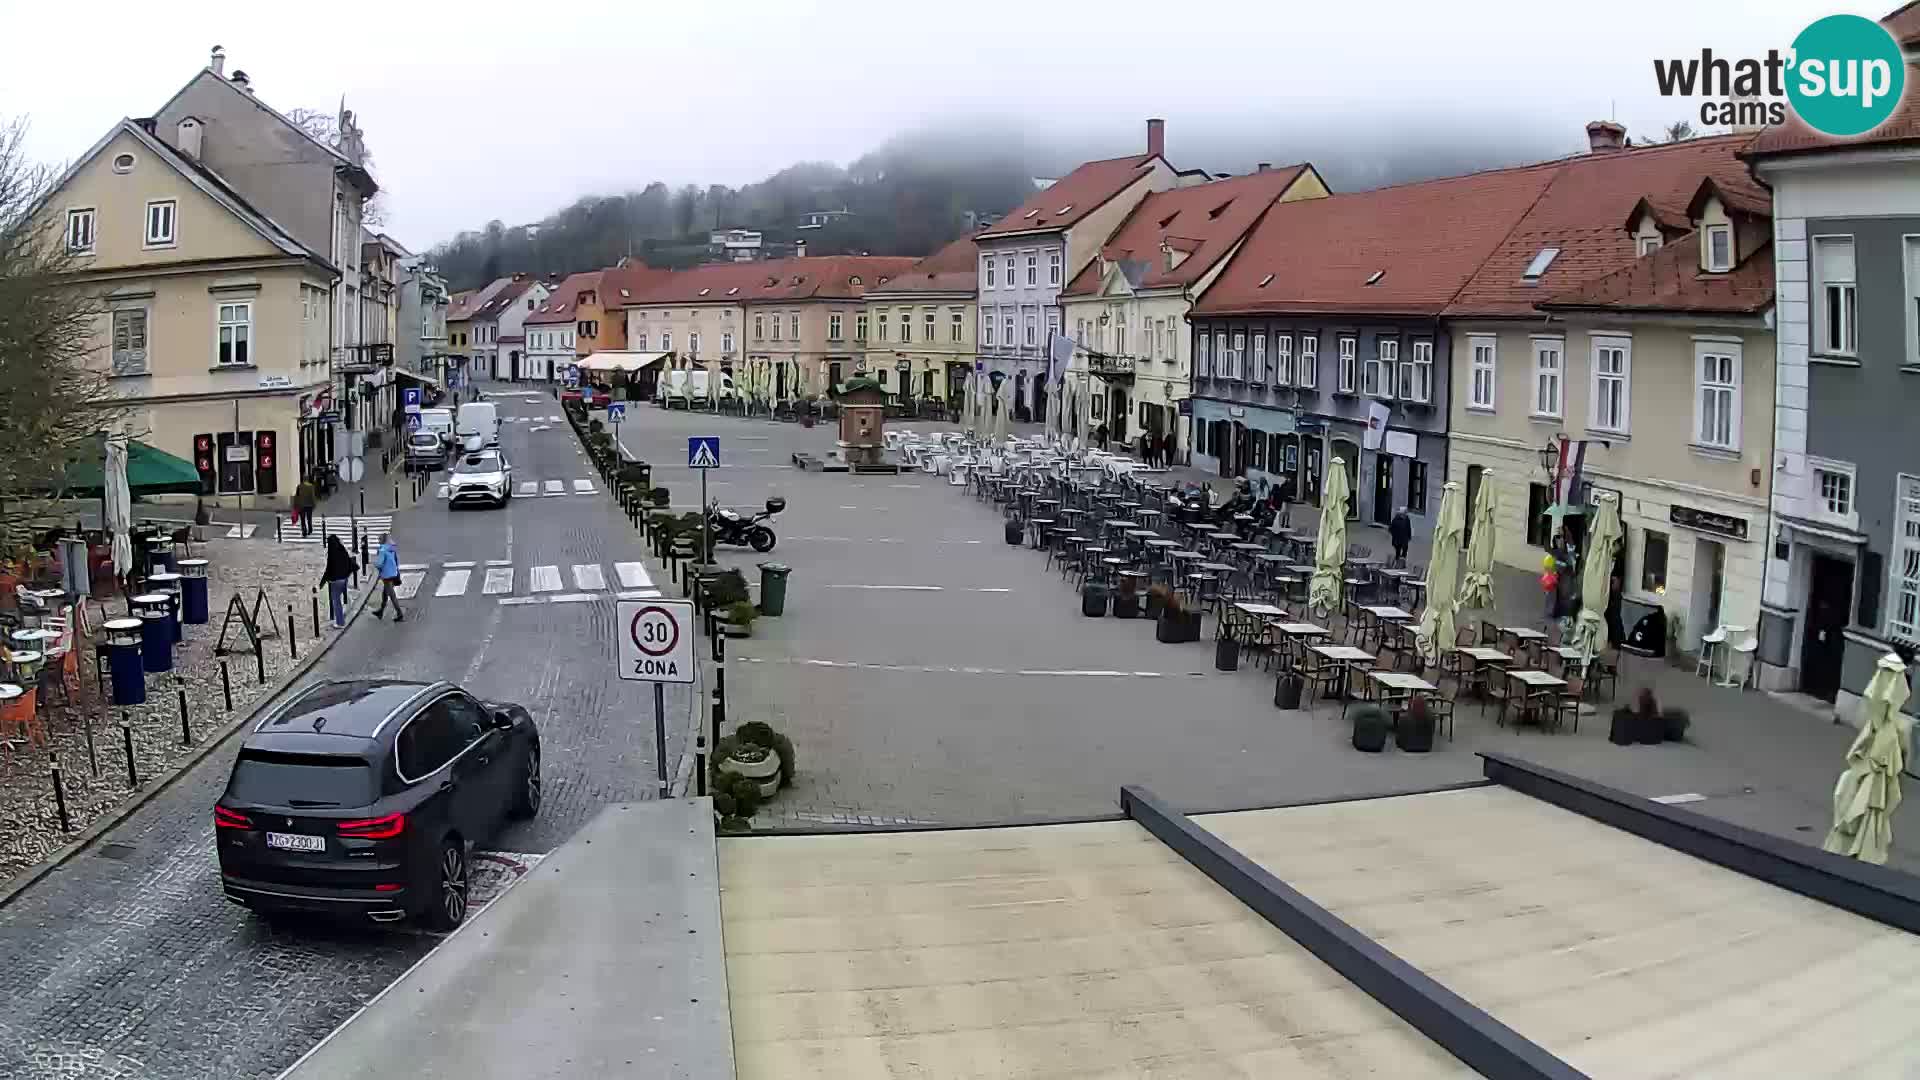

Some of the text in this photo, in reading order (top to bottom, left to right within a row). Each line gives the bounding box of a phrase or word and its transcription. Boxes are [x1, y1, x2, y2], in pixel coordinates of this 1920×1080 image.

[408, 391, 417, 402] P
[643, 622, 667, 643] 30
[634, 660, 678, 676] ZONA
